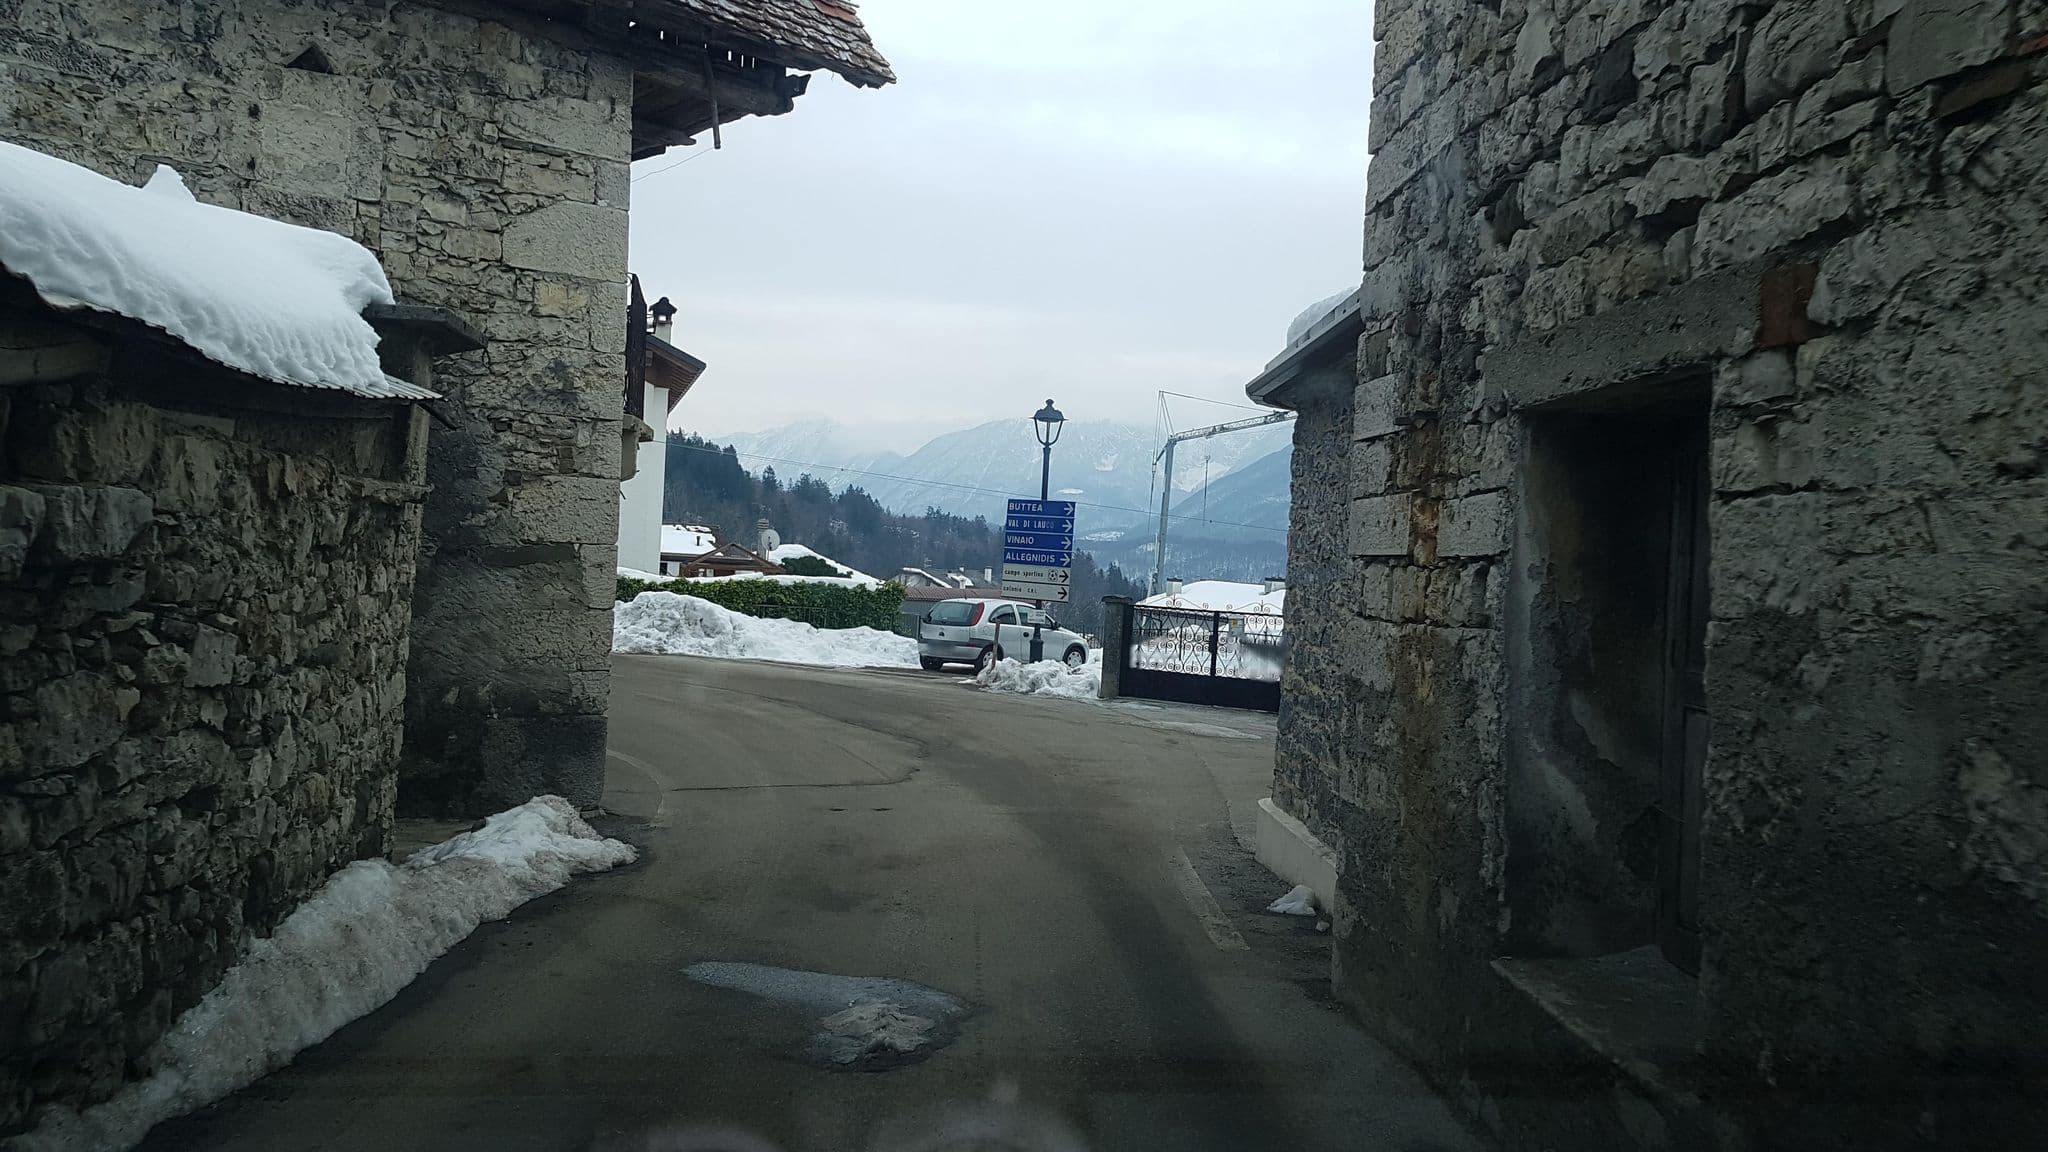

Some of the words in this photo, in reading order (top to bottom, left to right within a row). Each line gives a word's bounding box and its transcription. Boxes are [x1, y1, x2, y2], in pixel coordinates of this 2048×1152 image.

[1008, 502, 1043, 512] BUTTEA
[1008, 519, 1019, 528] VAL
[1023, 520, 1030, 528] DI
[1007, 535, 1034, 545] VINAIO
[1005, 552, 1055, 563] ALLEGNIDIS
